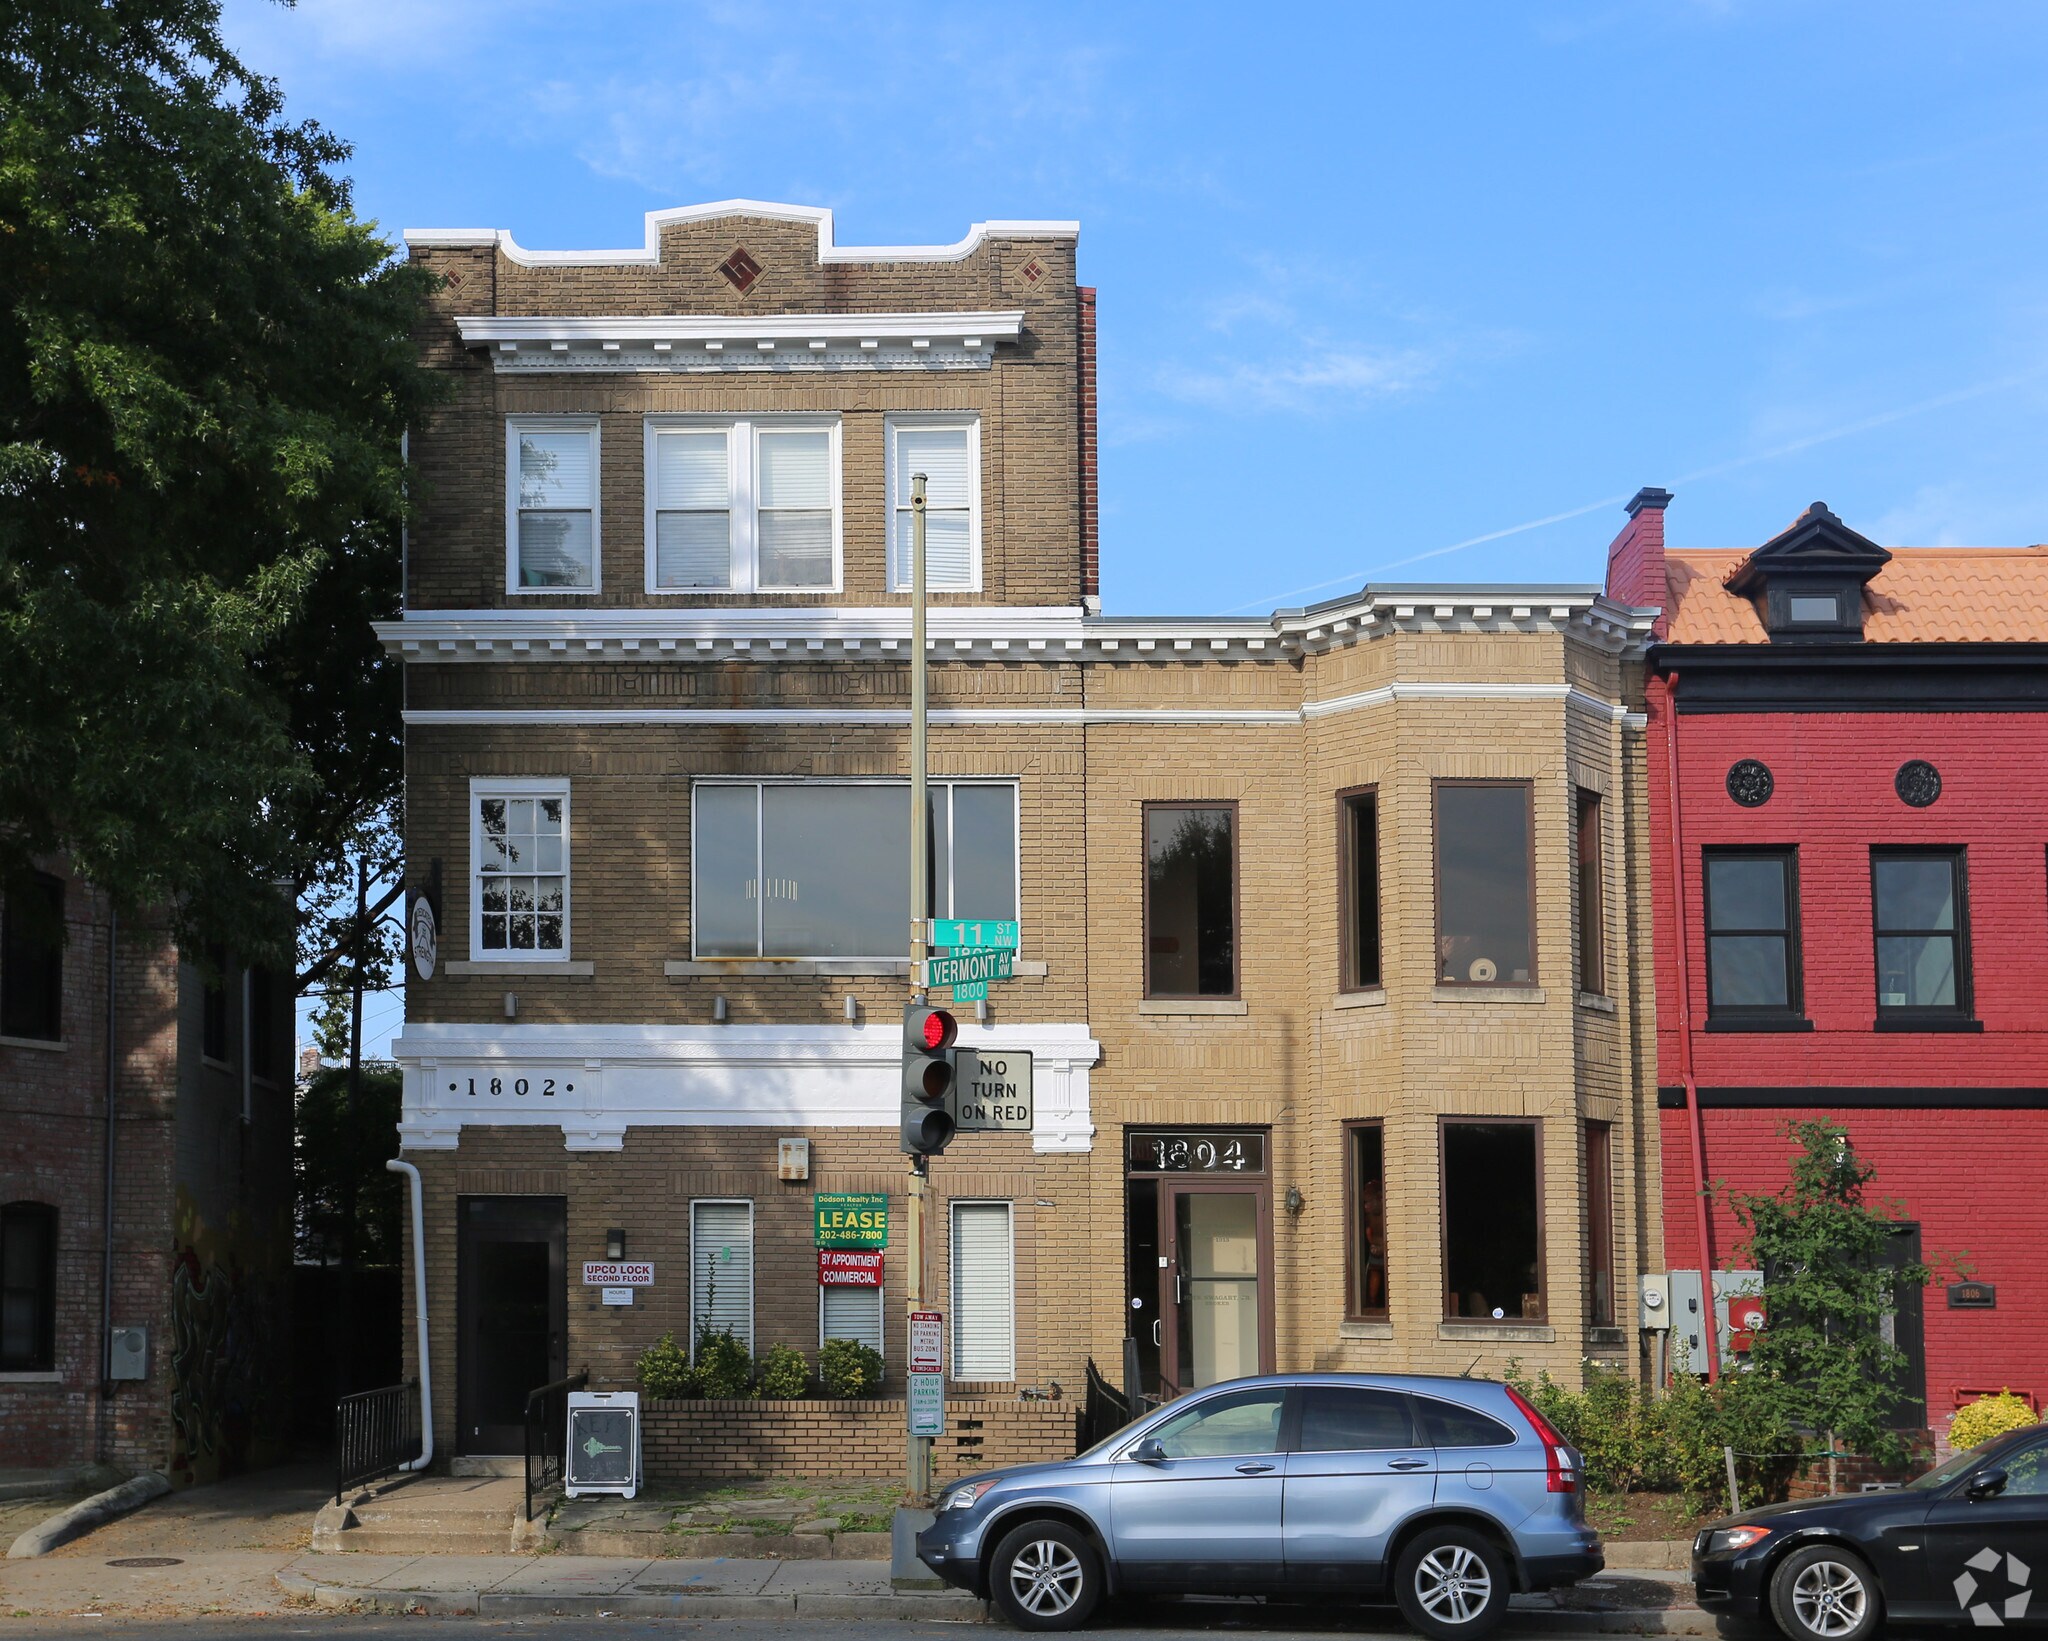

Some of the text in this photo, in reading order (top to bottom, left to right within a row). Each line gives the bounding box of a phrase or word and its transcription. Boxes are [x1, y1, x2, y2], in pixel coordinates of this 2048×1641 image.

[953, 923, 982, 945] 11
[996, 922, 1011, 934] ST
[994, 935, 1013, 946] NW
[998, 952, 1010, 963] AV
[933, 954, 996, 984] VERMONT
[998, 964, 1010, 976] NW
[956, 981, 984, 999] 1800
[980, 1060, 1007, 1076] NO
[467, 1077, 556, 1097] 1802
[971, 1082, 1016, 1098] TURN
[962, 1105, 1027, 1120] ON RED
[1151, 1139, 1246, 1170] 1804
[846, 1196, 869, 1204] Realty
[871, 1195, 884, 1203] Inc
[819, 1211, 886, 1228] LEASE
[819, 1230, 883, 1240] 202-486-7800
[821, 1253, 880, 1267] BY APPOINTMENT
[586, 1265, 650, 1275] UPCO LOCK
[823, 1271, 876, 1284] COMMERCIAL
[1962, 1288, 1980, 1298] 1806
[913, 1388, 939, 1396] PARKING
